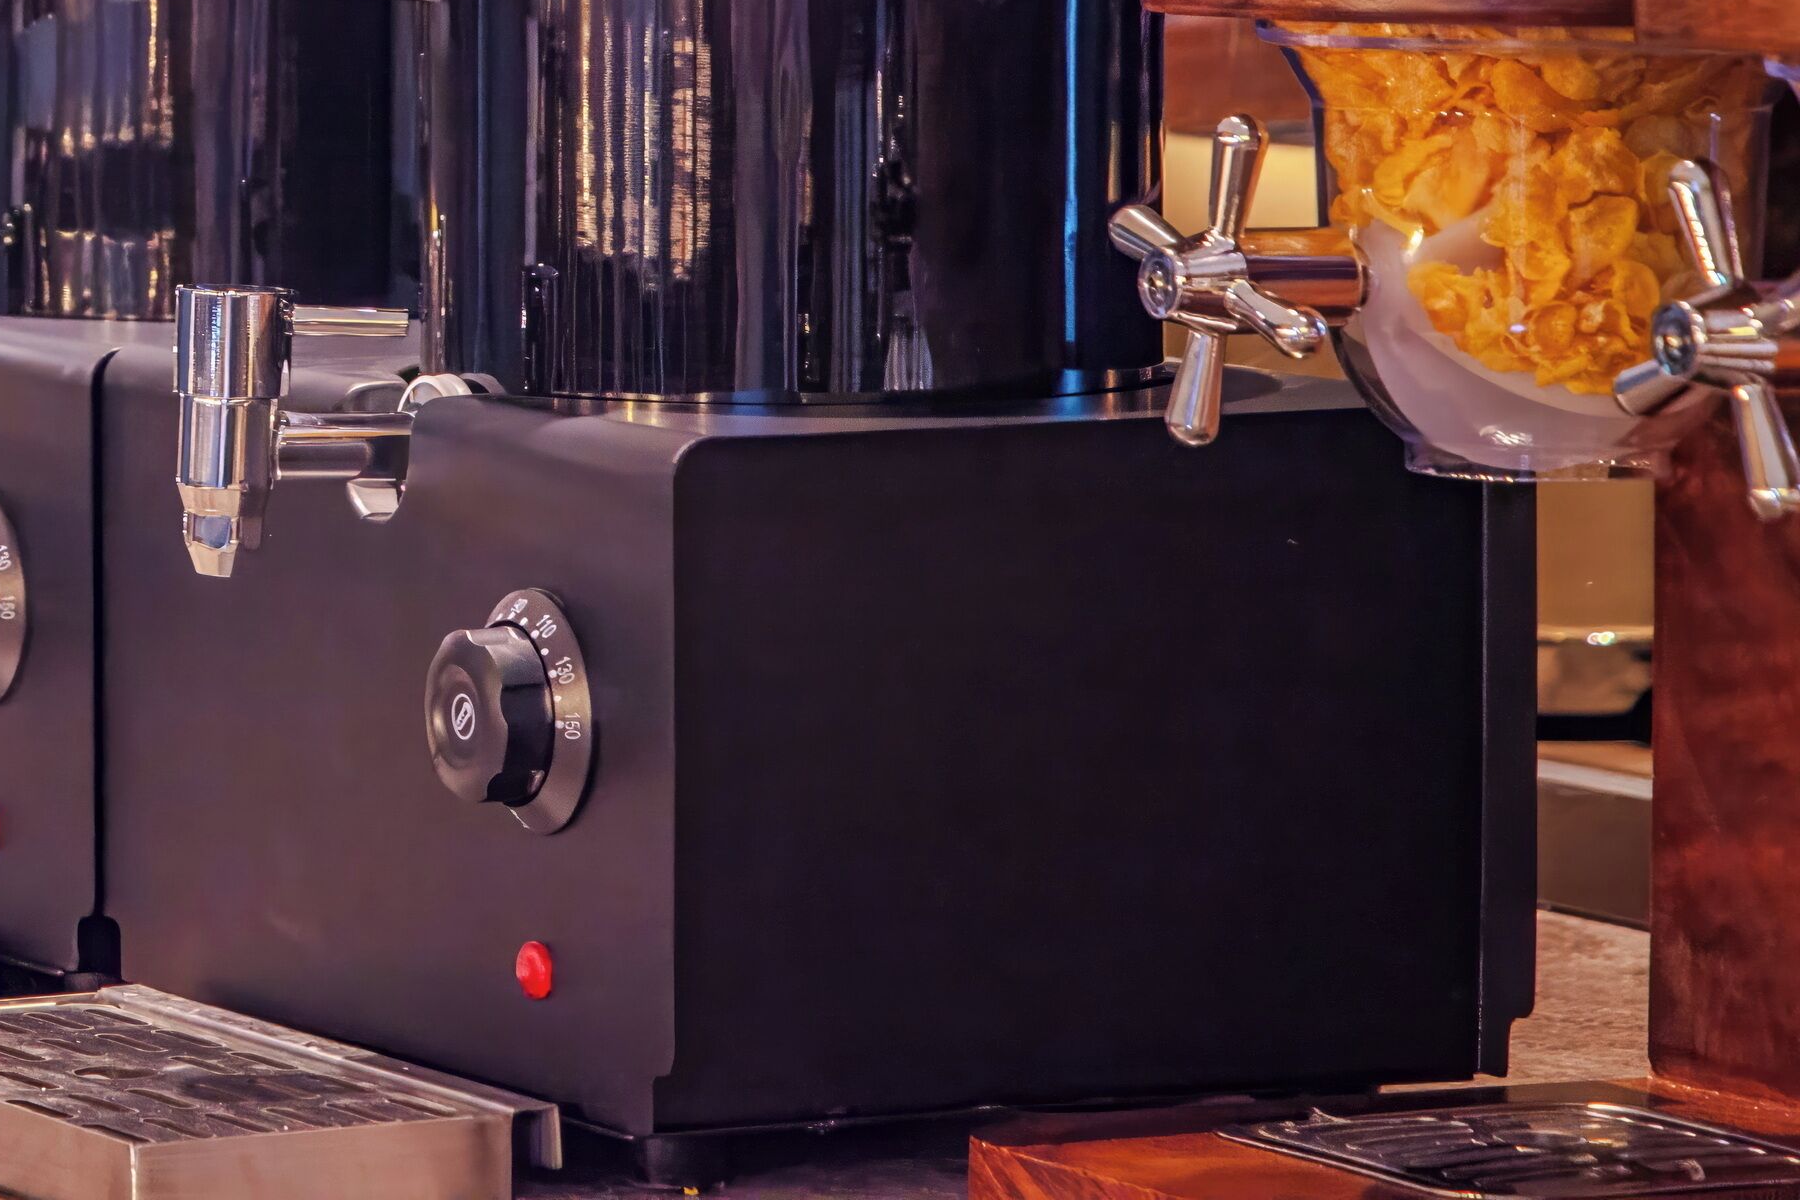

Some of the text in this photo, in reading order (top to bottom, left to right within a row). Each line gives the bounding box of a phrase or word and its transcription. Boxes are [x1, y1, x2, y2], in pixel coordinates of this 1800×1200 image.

[535, 614, 558, 639] 110
[555, 656, 576, 685] 130
[564, 712, 582, 740] 150
